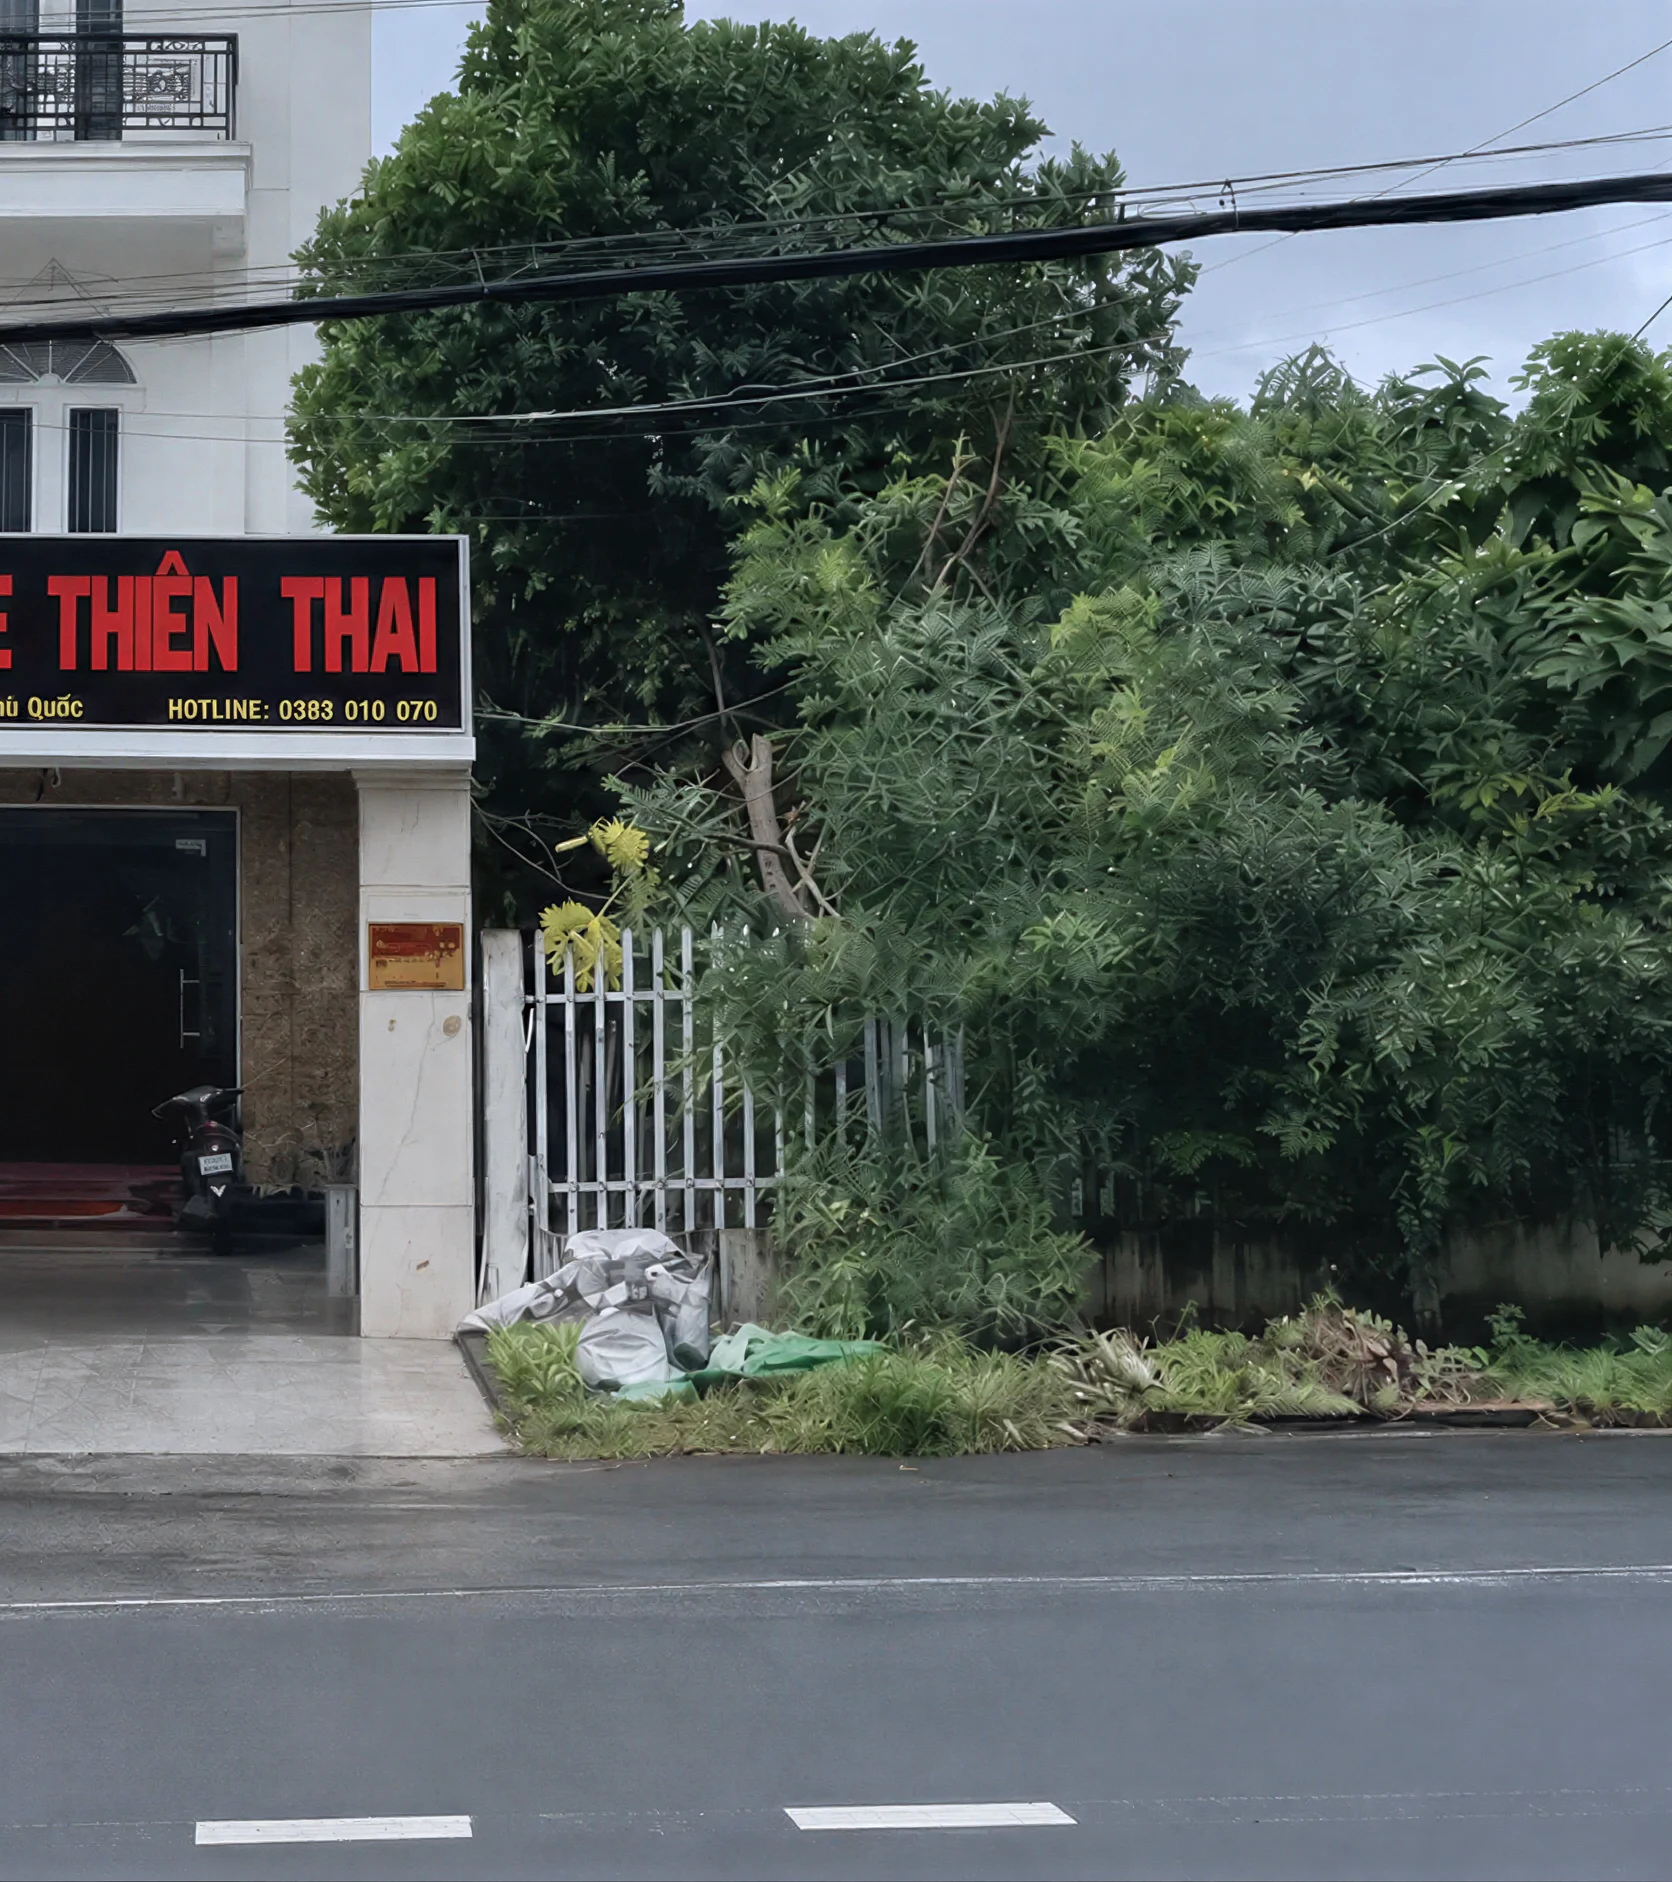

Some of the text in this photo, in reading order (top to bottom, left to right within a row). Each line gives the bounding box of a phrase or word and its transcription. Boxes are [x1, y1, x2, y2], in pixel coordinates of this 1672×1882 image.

[46, 549, 239, 672] THIÊN
[280, 575, 438, 673] THAI
[168, 698, 438, 721] HOTLINE: 0383 010 070
